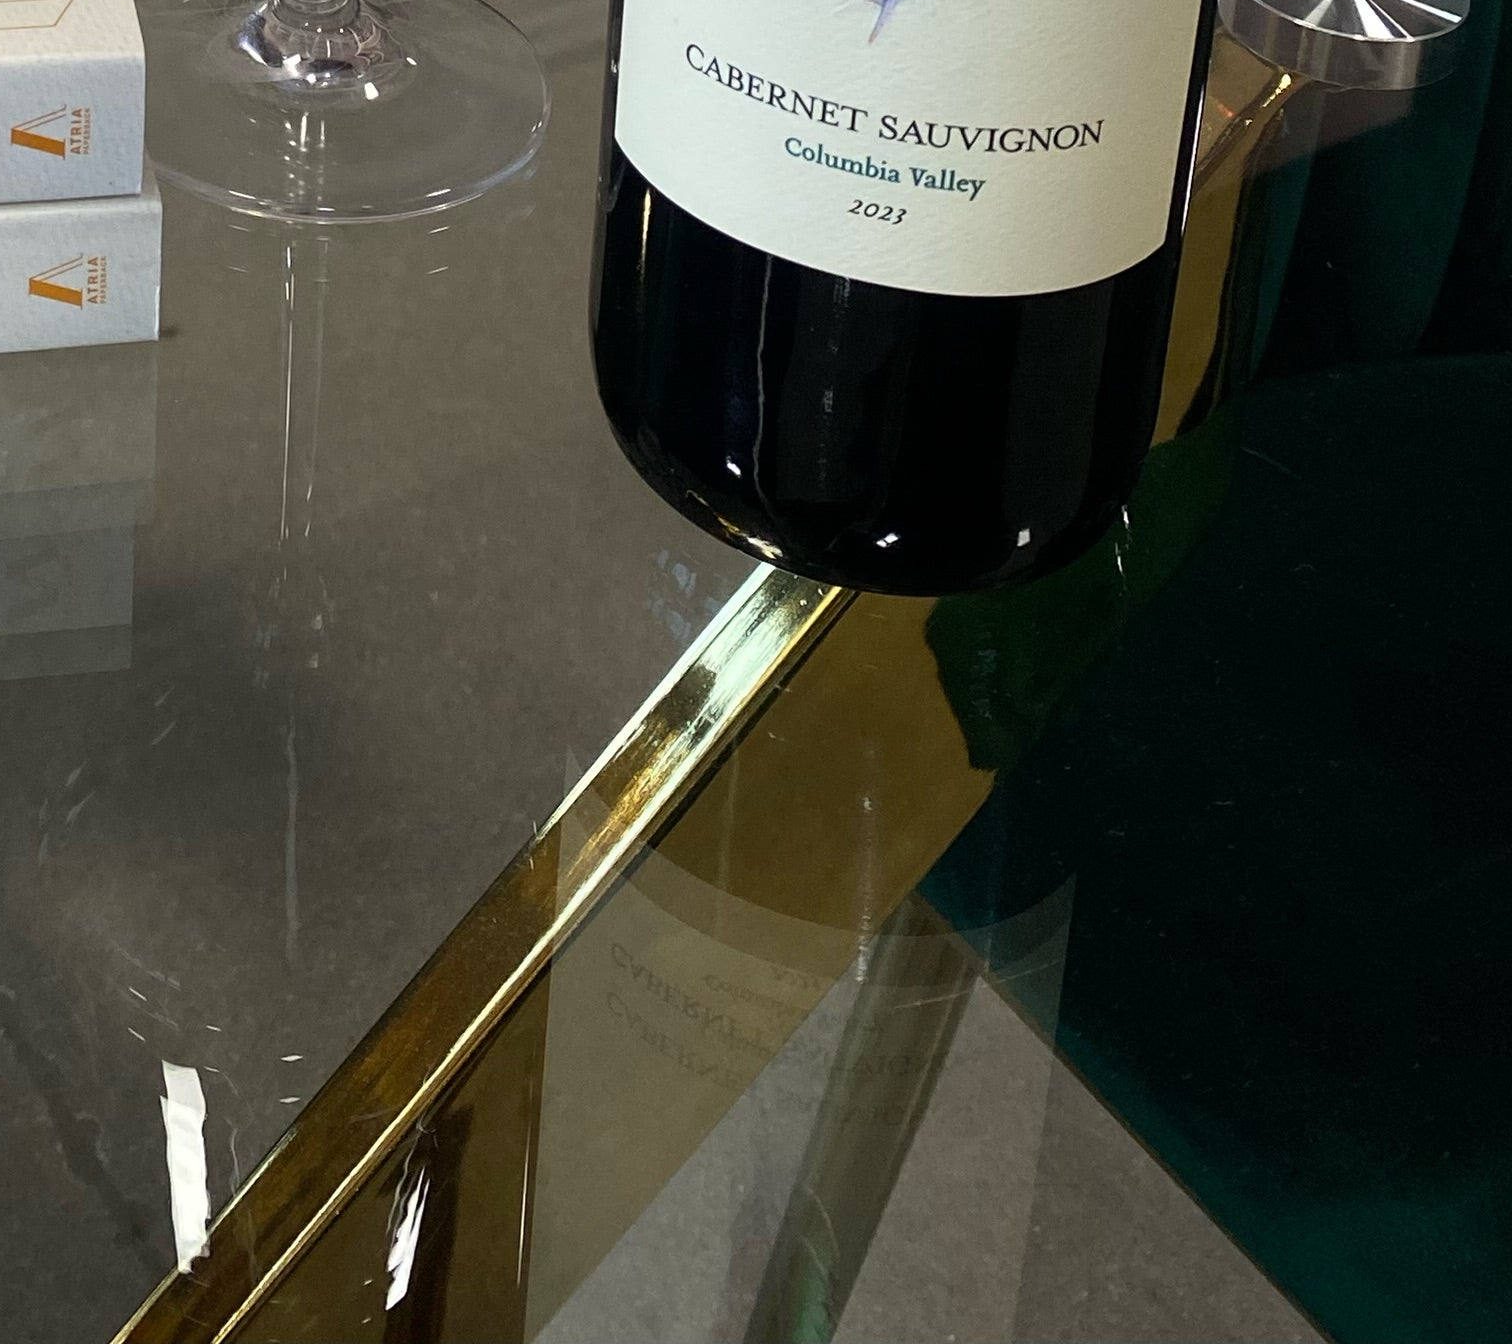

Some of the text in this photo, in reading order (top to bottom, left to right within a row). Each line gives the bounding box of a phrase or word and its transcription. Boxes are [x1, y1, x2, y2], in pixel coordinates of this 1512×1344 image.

[685, 44, 1104, 154] CABERNET SAUVIGNON
[70, 108, 83, 155] ATRIA
[785, 137, 986, 201] Columbia Valley
[848, 199, 908, 226] 2023
[87, 256, 99, 304] ATRIA
